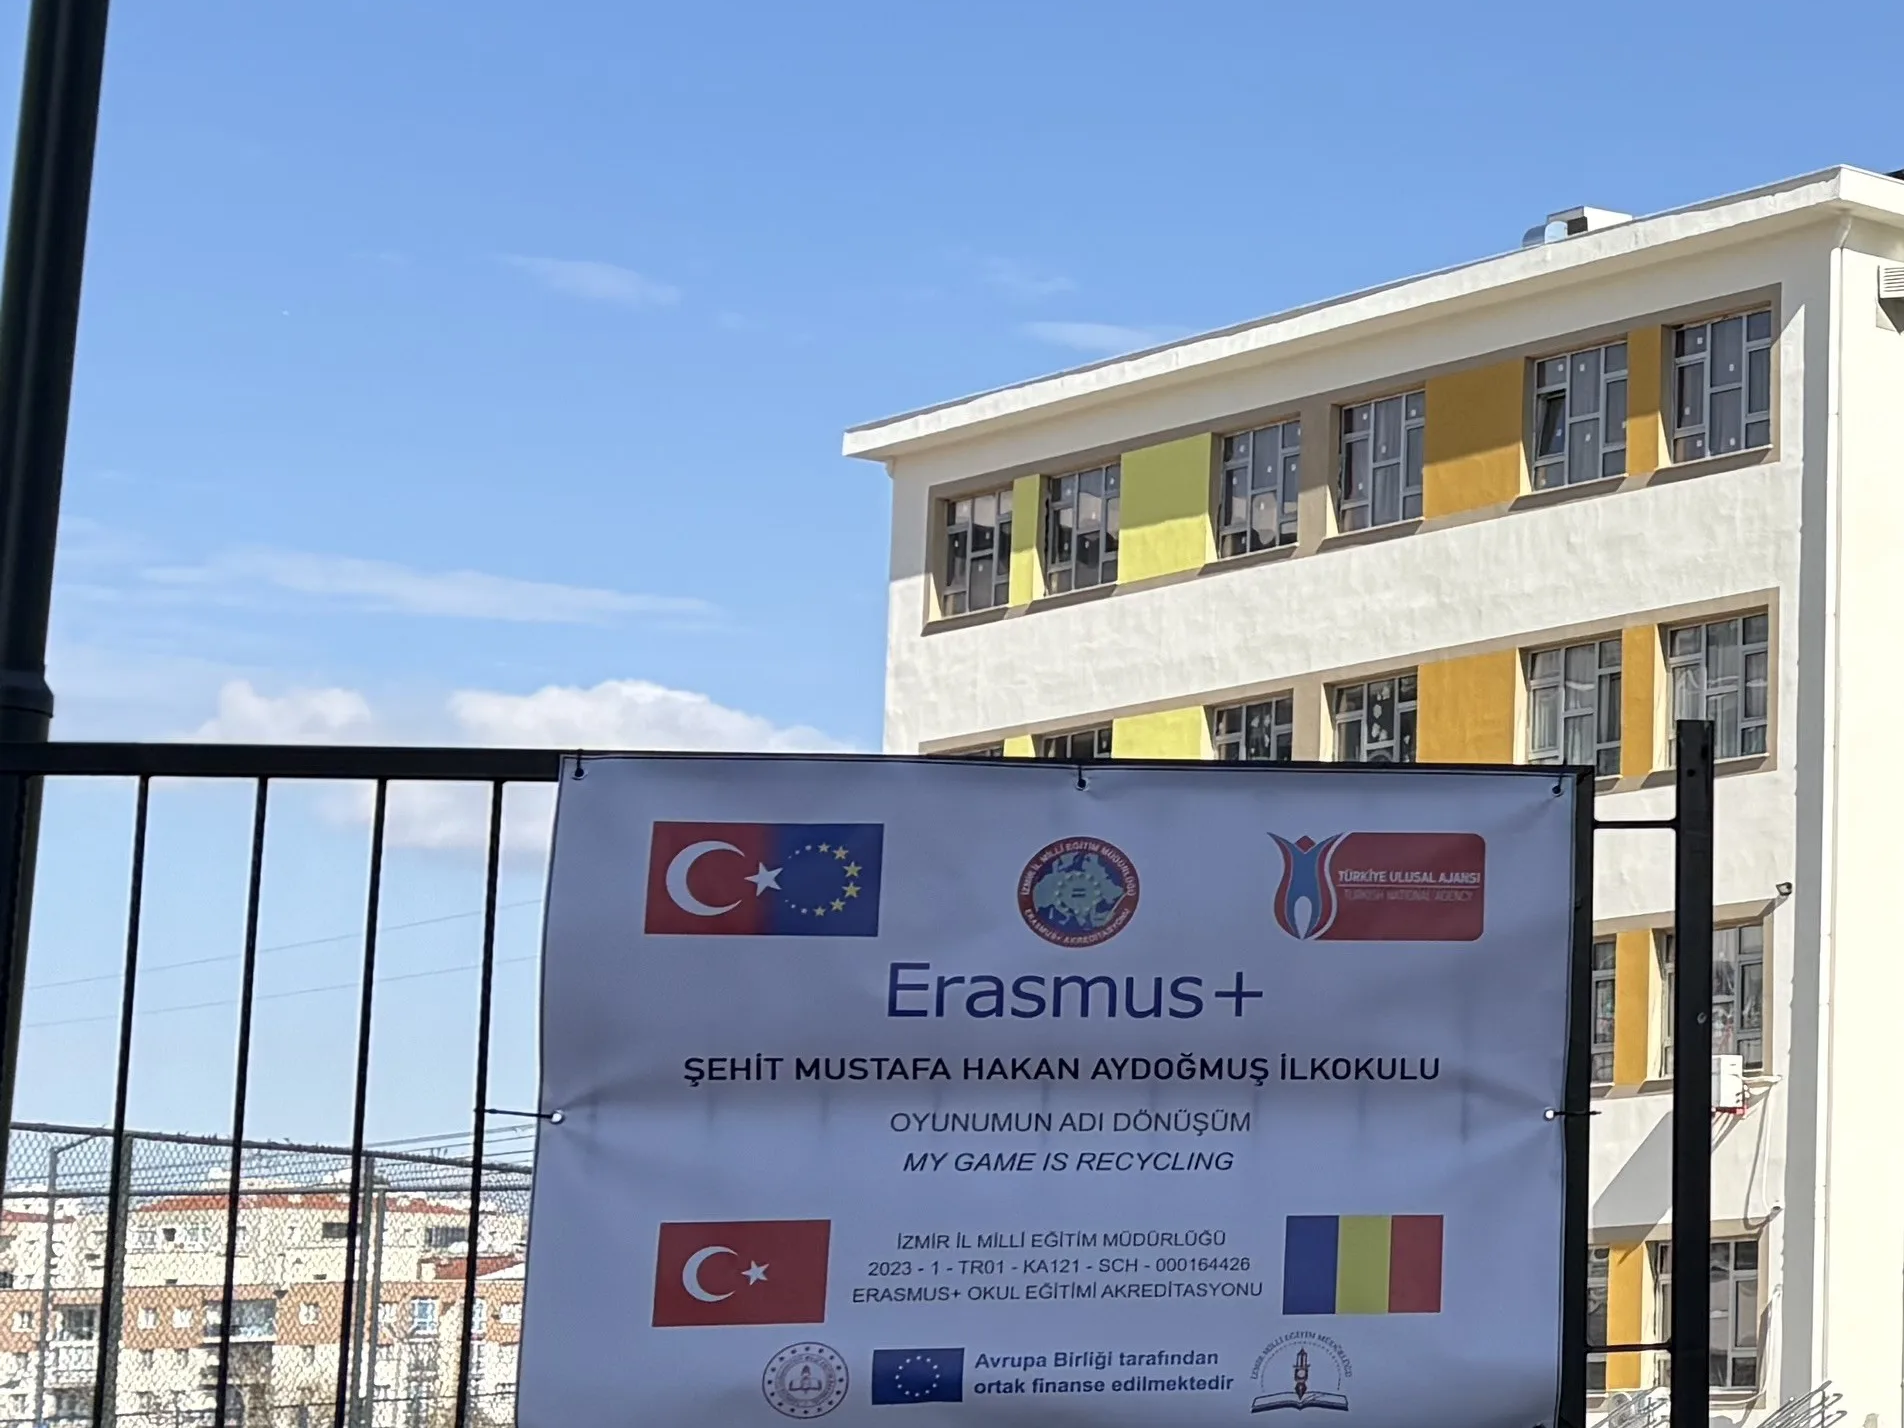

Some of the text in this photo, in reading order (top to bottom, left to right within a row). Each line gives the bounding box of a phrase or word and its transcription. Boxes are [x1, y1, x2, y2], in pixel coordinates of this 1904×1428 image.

[1338, 868, 1387, 883] TÜRKİYE
[1389, 870, 1437, 883] ULUSAL
[887, 961, 1265, 1020] Erasmus+
[683, 1052, 1441, 1088] ŞEHİT MUSTAFA HAKAN AYDOĞMUŞ İLKOKULU
[890, 1108, 1252, 1137] OYUNUMUN ADI DÖNÜŞÜM
[902, 1151, 1235, 1172] MY GAME IS RECYCLING
[896, 1228, 1227, 1251] İZMİR İL MİLLİ EĞİTİM MÜDÜRLÜĞÜ
[867, 1260, 914, 1277] 2023
[930, 1261, 940, 1277] 1
[957, 1259, 1004, 1276] TR01
[1023, 1258, 1080, 1274] KA121
[1098, 1257, 1139, 1274] SCH
[1154, 1256, 1251, 1273] 000164426
[852, 1279, 1264, 1304] ERASMUS+ OKUL EĞİTİMİ AKREDİTASYONU
[974, 1349, 1220, 1372] Avrupa Birliği tarafından
[973, 1373, 1235, 1395] ortak finanse edilmektedir
